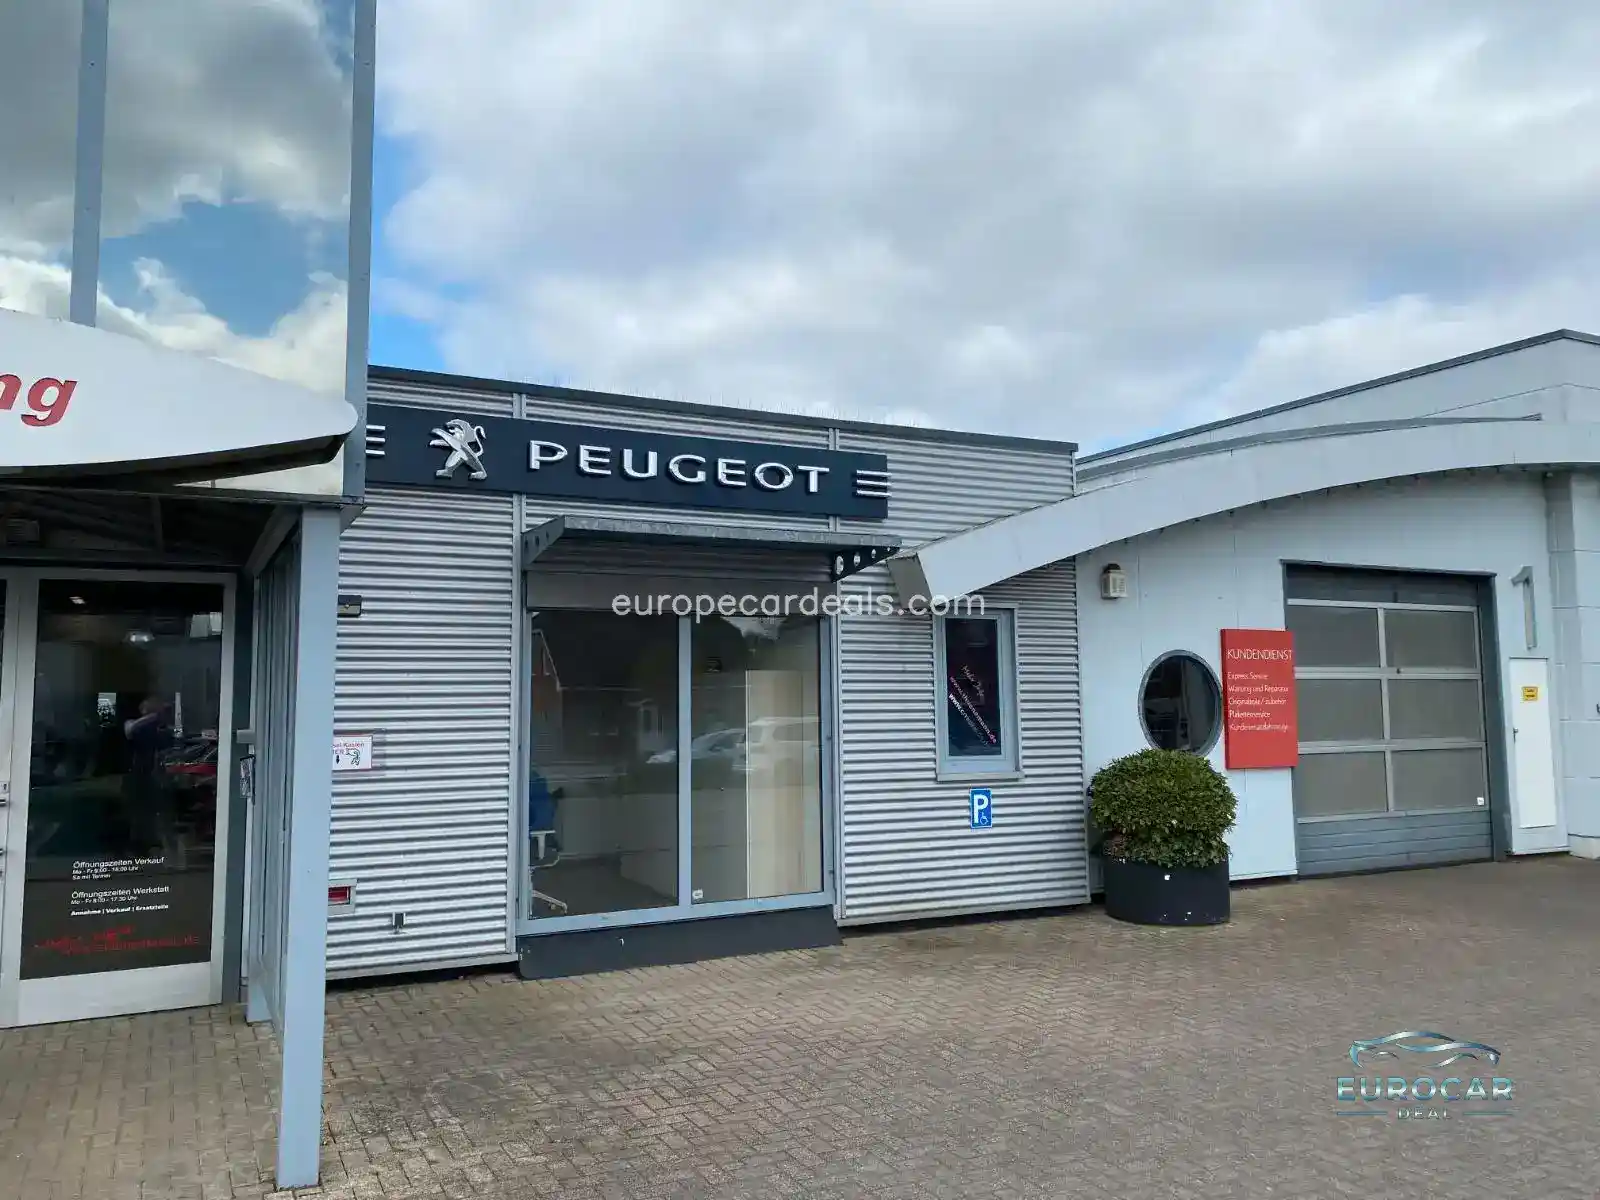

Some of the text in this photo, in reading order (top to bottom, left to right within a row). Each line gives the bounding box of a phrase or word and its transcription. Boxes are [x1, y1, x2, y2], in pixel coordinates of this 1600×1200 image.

[529, 439, 830, 493] PEUGEOT
[1227, 648, 1292, 661] KUNDENDIENST
[1252, 684, 1264, 693] und
[973, 794, 988, 823] P
[73, 856, 165, 869] Öffnungszeiten Verkauf
[71, 886, 170, 899] Öffnungszeiten Werkstatt
